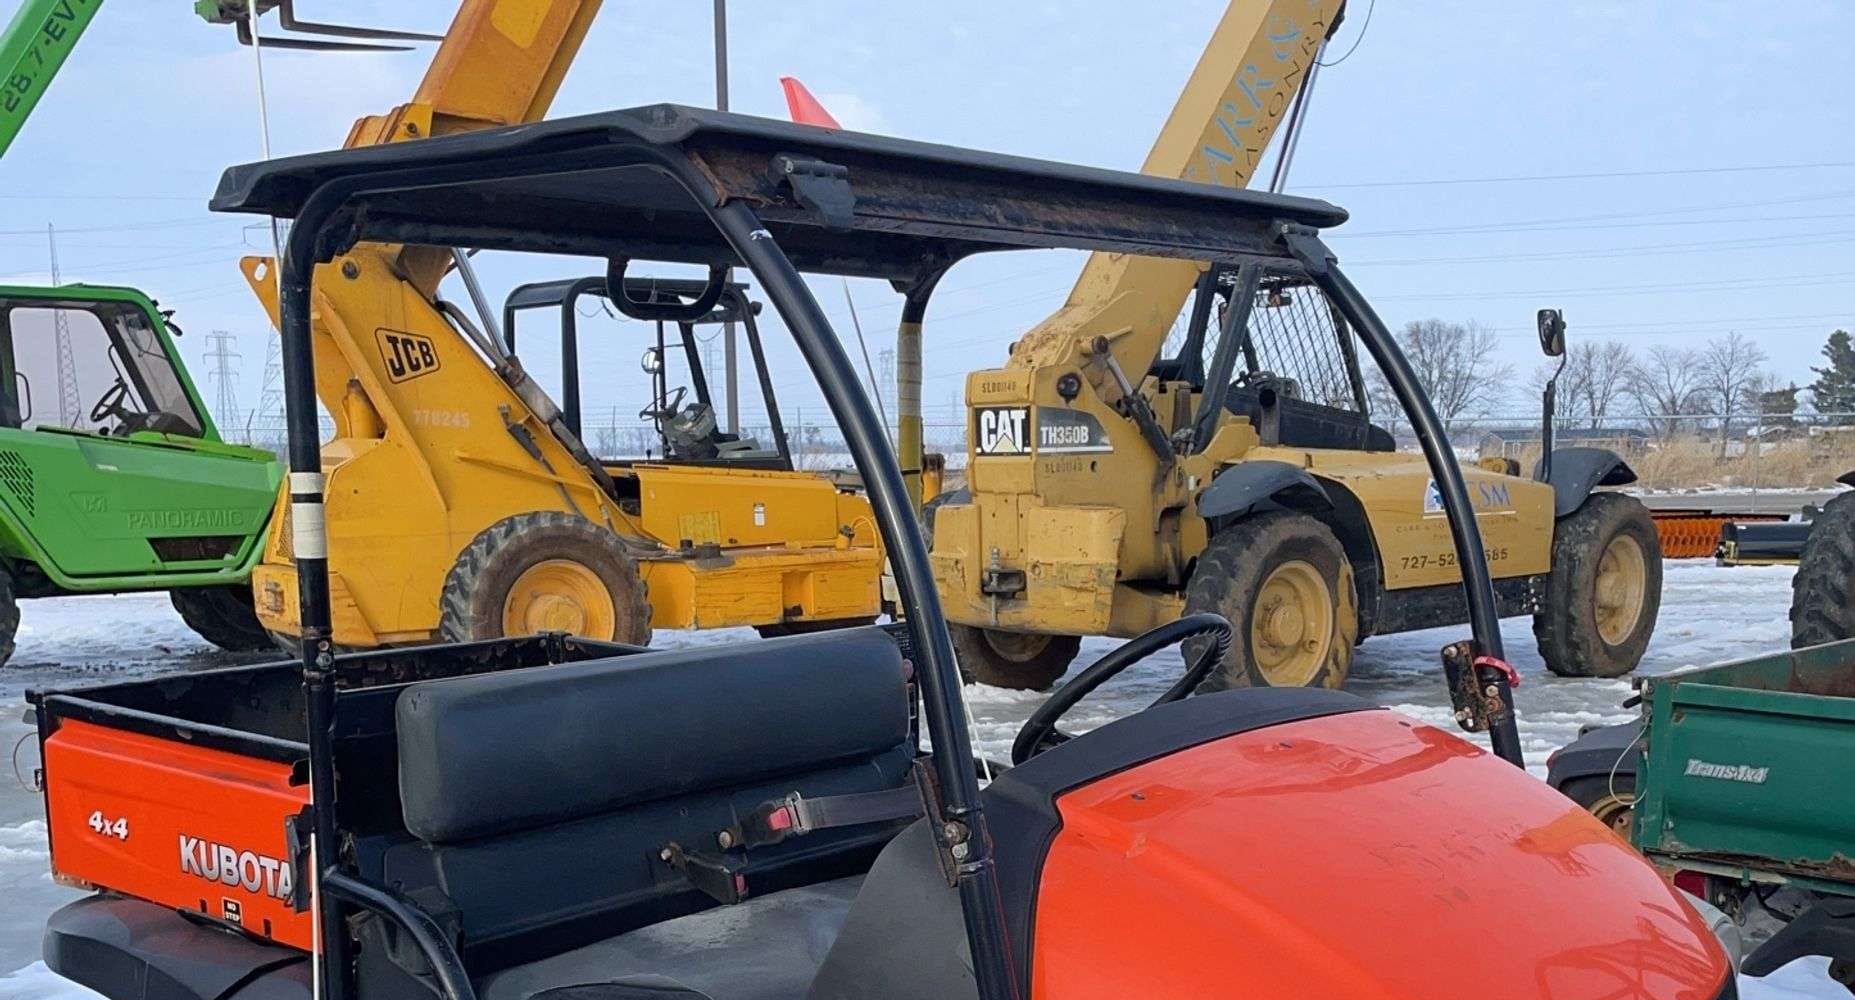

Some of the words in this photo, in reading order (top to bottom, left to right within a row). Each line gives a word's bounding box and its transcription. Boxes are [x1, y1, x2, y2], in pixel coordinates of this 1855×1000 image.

[3, 0, 86, 113] 28.7-EV
[385, 334, 436, 378] JCB
[980, 409, 1028, 453] CAT
[1040, 425, 1090, 444] TH350B
[127, 509, 245, 530] PANORAMIC
[88, 810, 129, 840] 4x4
[178, 834, 294, 902] KUBOTA
